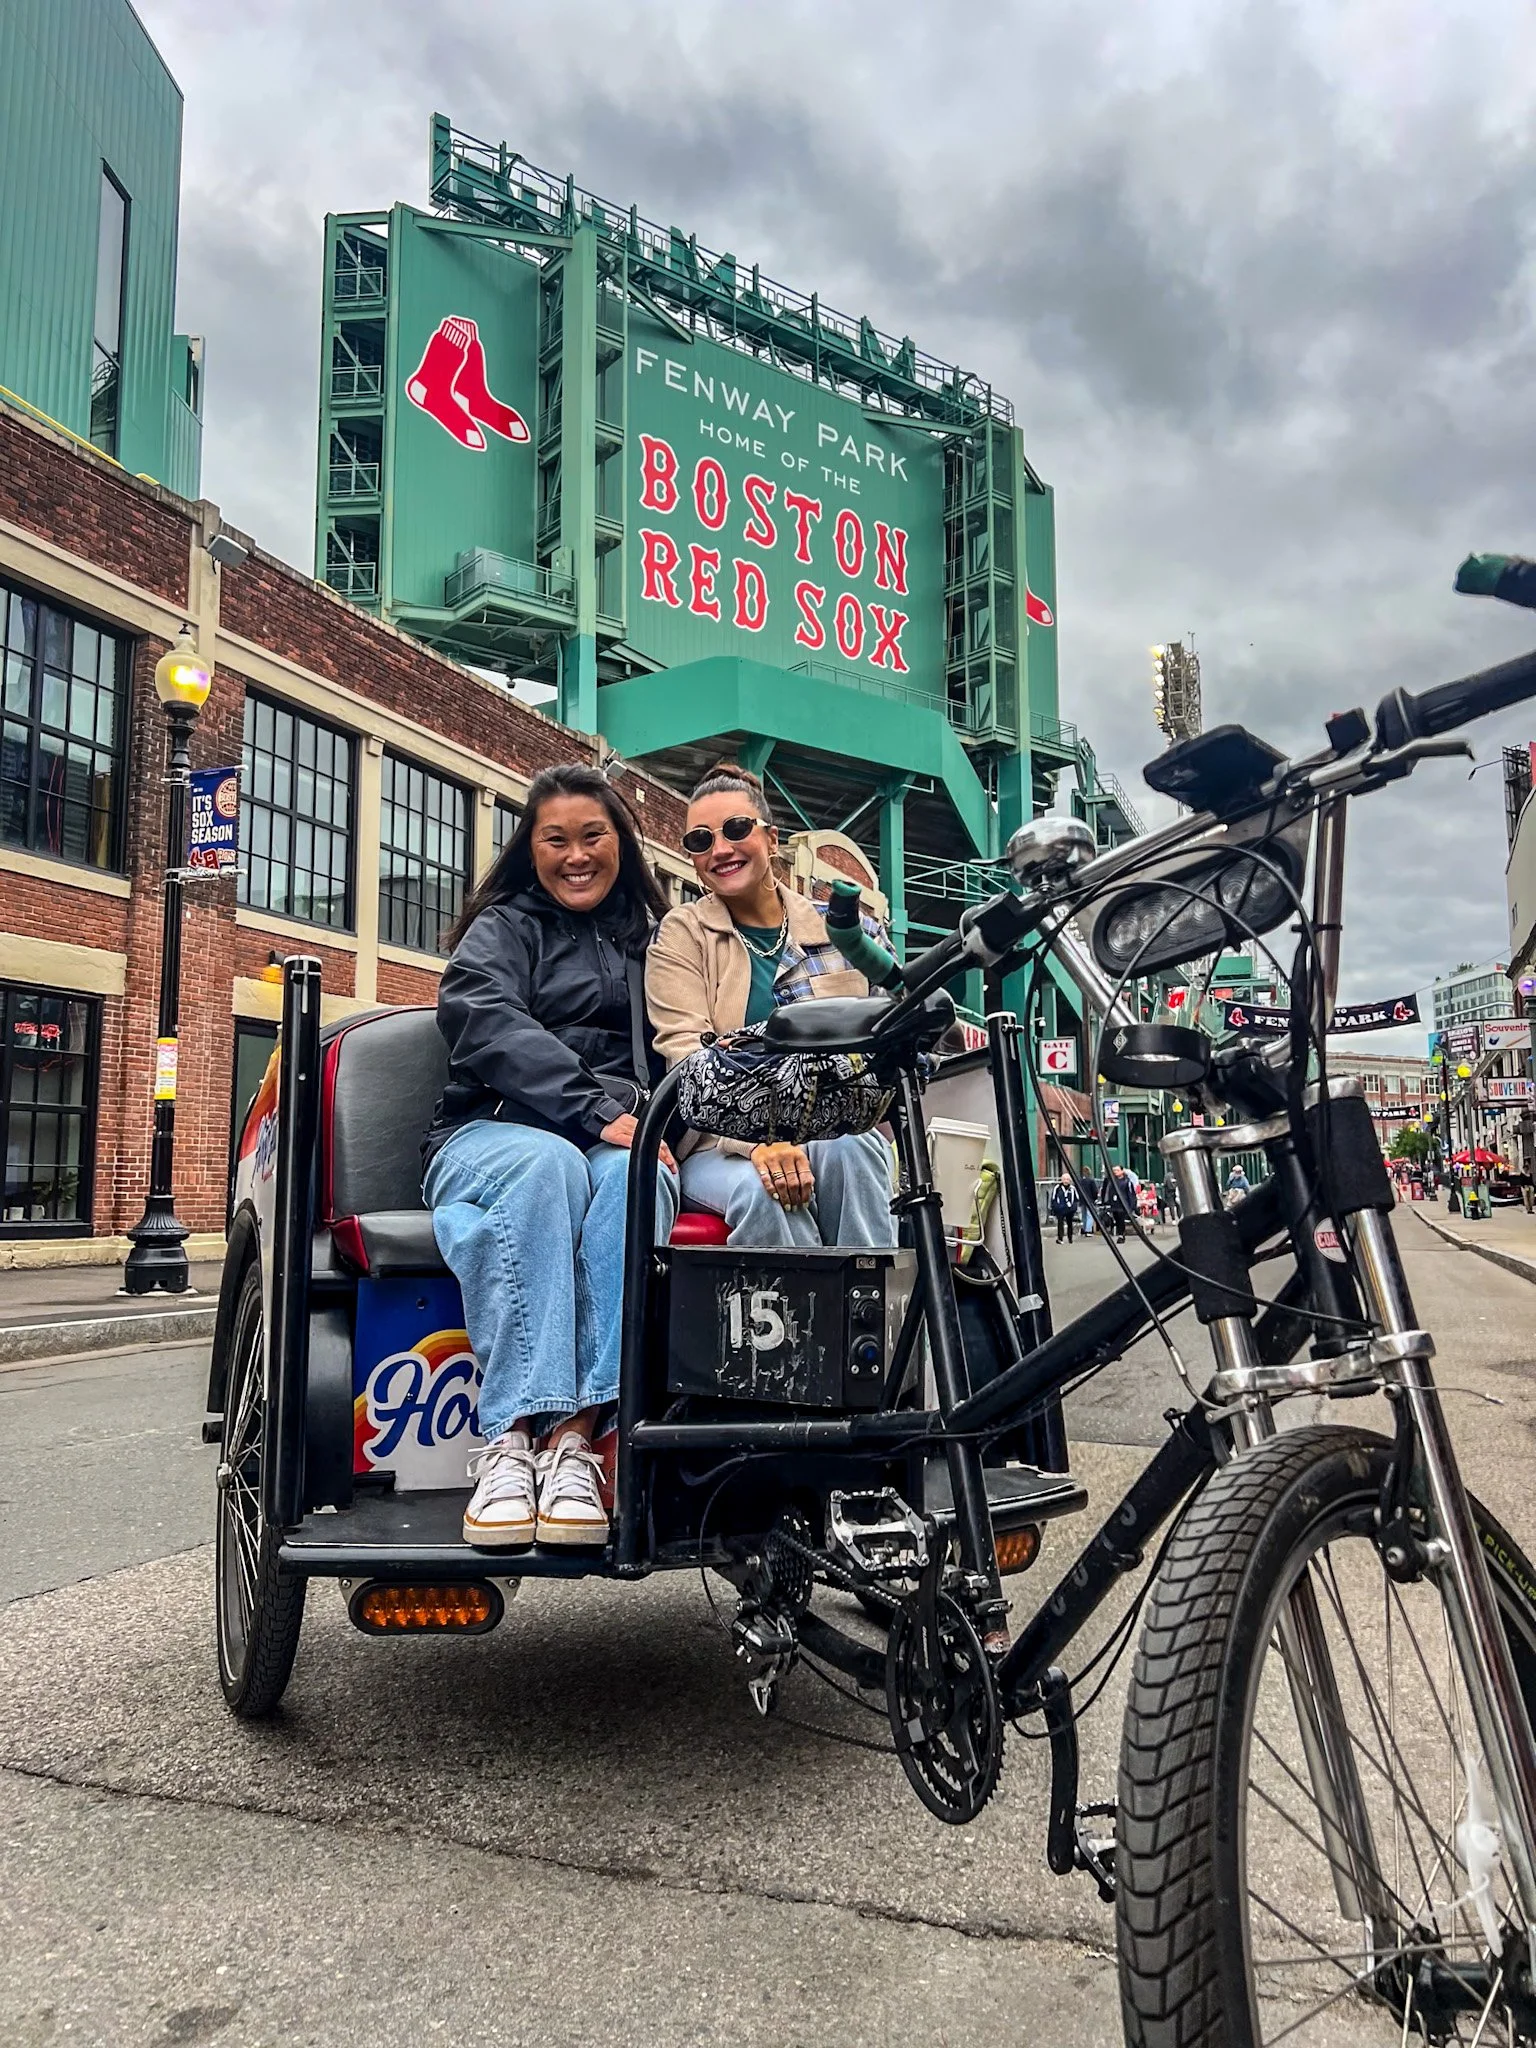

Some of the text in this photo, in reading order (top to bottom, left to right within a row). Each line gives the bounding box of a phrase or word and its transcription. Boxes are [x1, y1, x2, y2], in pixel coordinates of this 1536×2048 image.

[635, 346, 909, 482] FENWAY PARK
[700, 419, 861, 495] HOME OF THE
[638, 432, 910, 596] BOSTON
[638, 528, 910, 674] RED SOX
[192, 794, 213, 812] IT'S
[192, 810, 214, 828] SOX
[191, 824, 234, 845] SEASON
[1254, 1010, 1388, 1028] FEN PARK
[1047, 1051, 1068, 1069] C
[1490, 1081, 1527, 1095] SOUVENIR
[726, 1290, 785, 1351] 15
